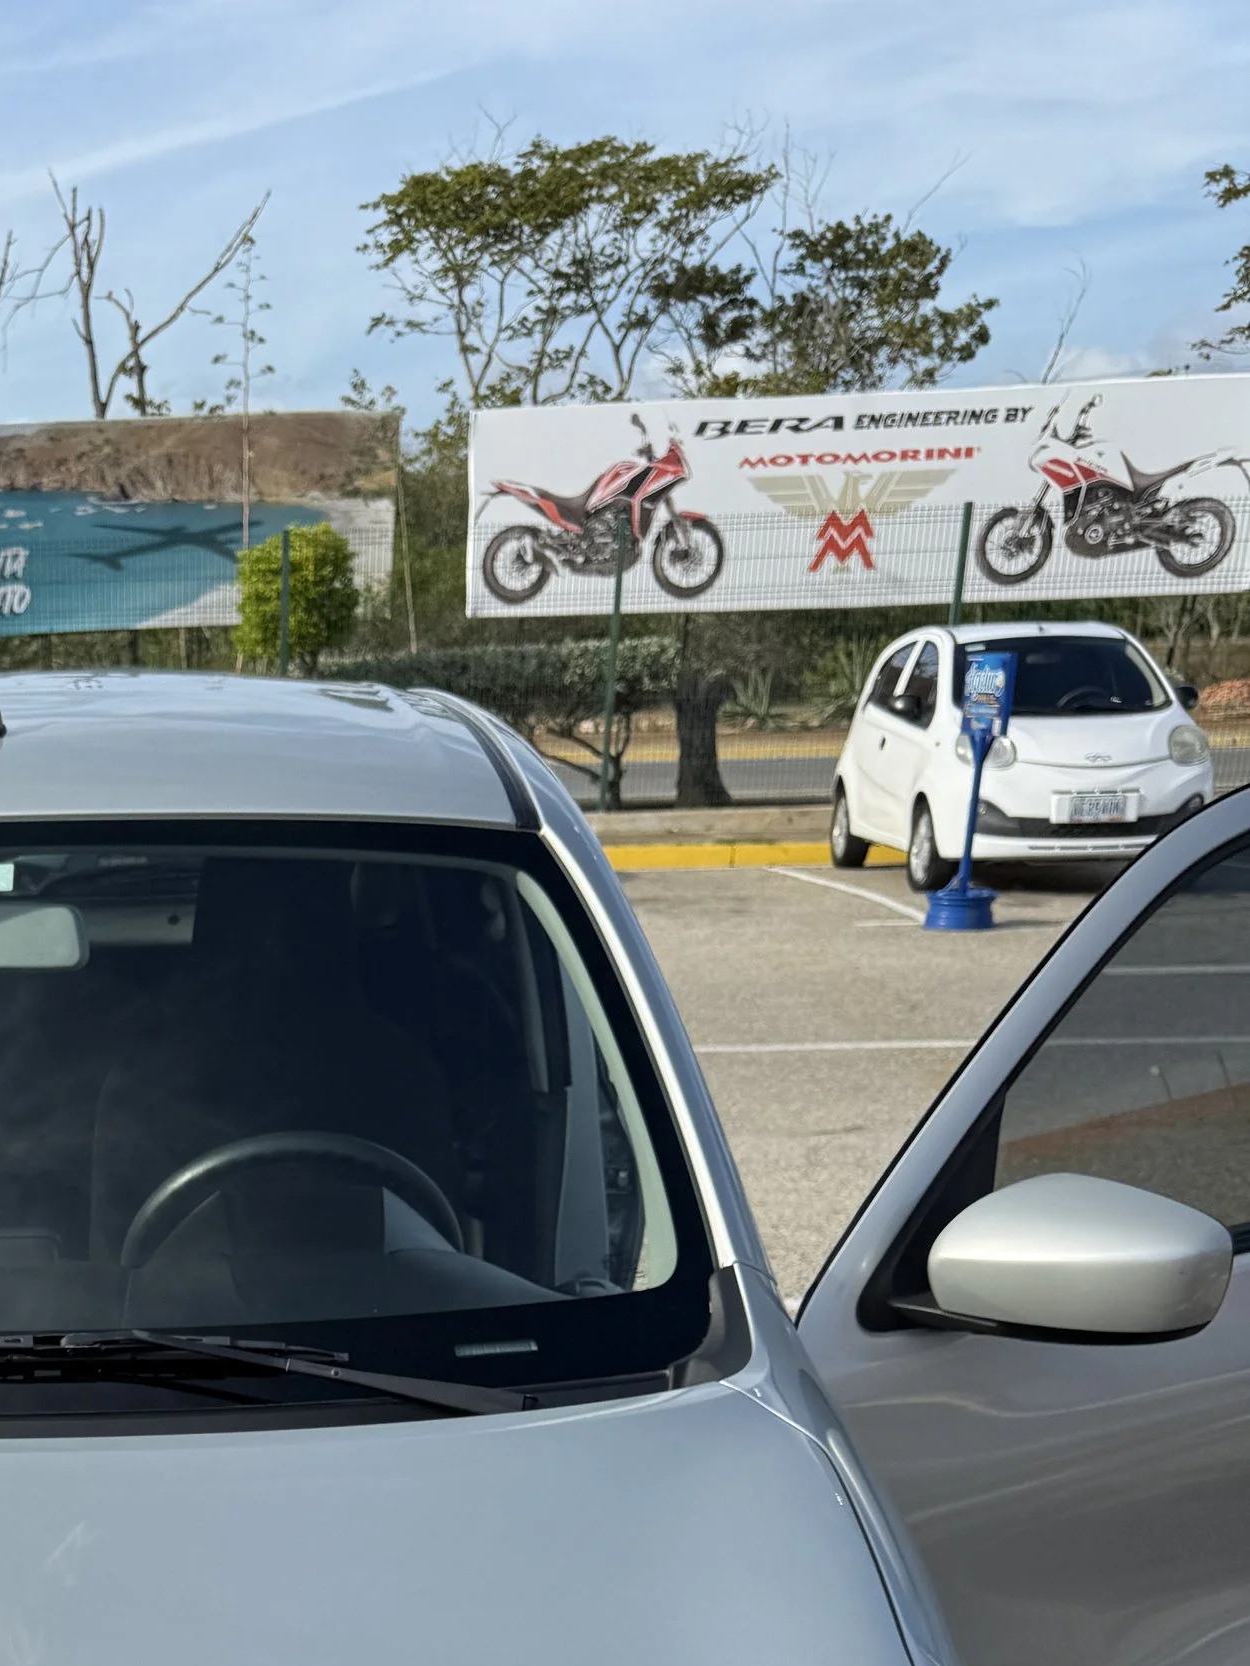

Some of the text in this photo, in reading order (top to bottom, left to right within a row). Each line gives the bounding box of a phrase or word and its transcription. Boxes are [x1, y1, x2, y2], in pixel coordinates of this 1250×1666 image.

[694, 405, 1035, 440] BERA ENGINEERING BY
